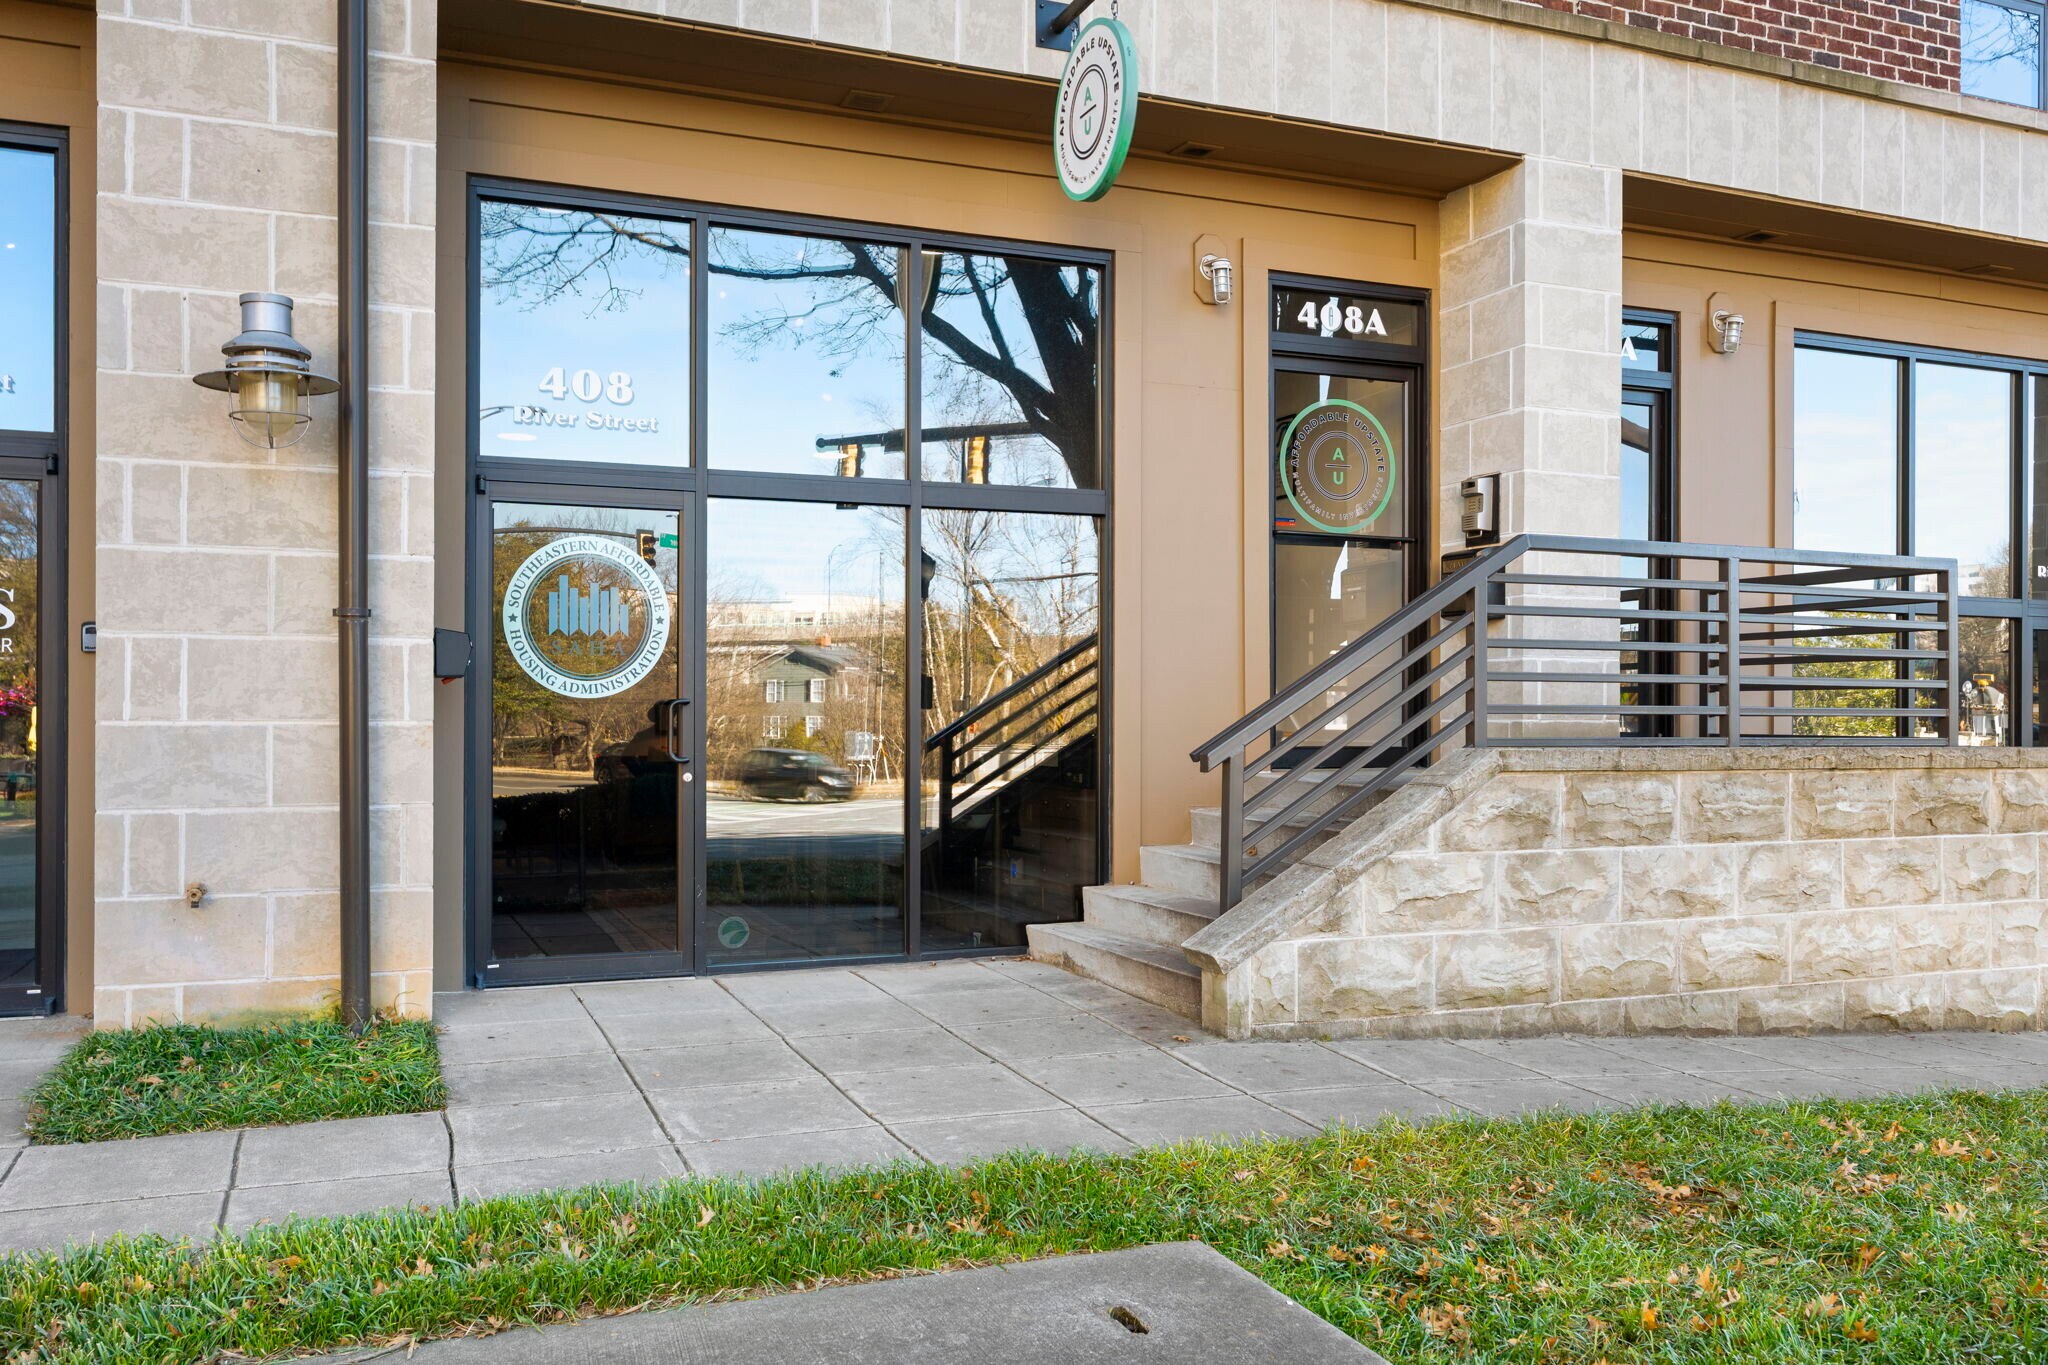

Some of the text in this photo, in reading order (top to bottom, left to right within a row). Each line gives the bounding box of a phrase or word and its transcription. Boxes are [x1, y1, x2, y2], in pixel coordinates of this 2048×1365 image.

[1059, 36, 1120, 136] AFFORDABLE UPSTATE
[1083, 86, 1092, 106] A
[1083, 118, 1092, 135] U
[1297, 301, 1388, 337] 408A
[538, 367, 635, 406] 408
[513, 403, 660, 433] River Street
[1290, 411, 1386, 473] AFFORDABLE UPSTATE
[1332, 447, 1345, 462] A
[1332, 471, 1345, 486] U
[508, 540, 665, 613] SOUTHEASTERN AFFORDABLE
[509, 629, 664, 695] HOUSING ADMINISTRATION
[551, 639, 627, 657] SAHA
